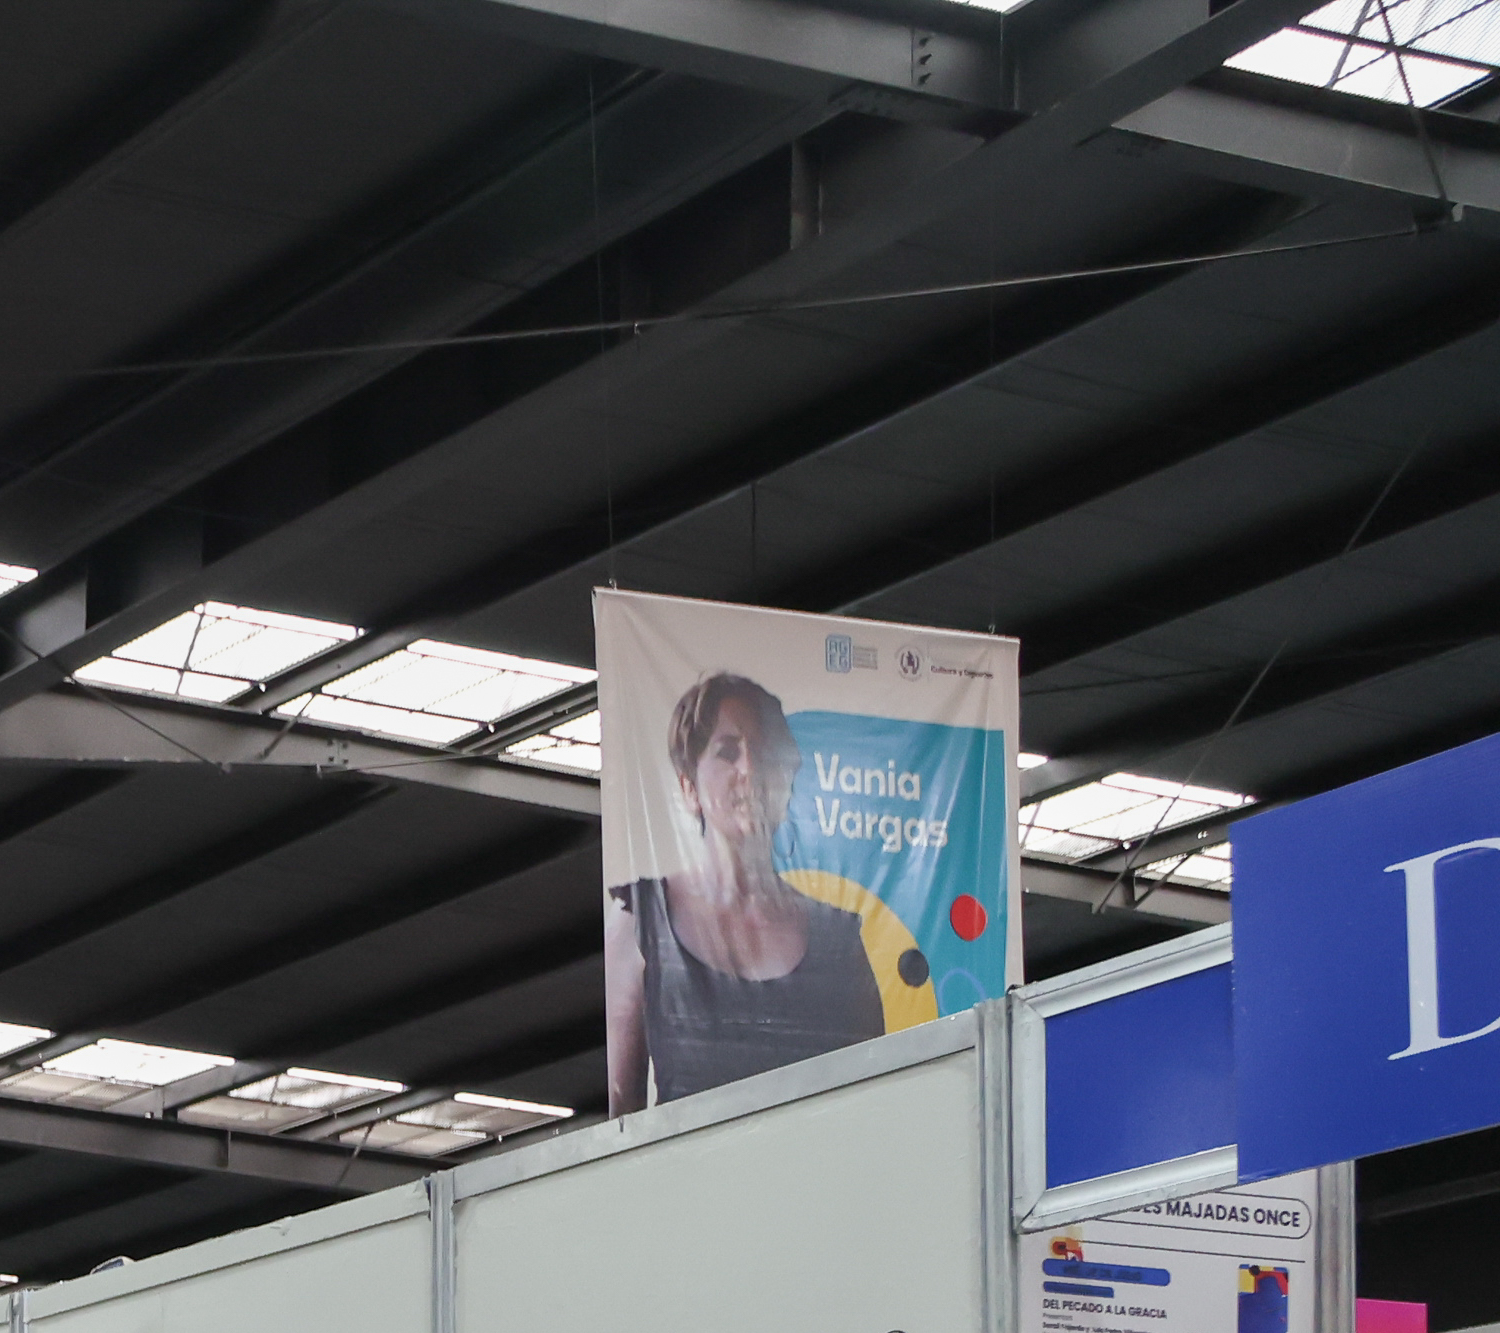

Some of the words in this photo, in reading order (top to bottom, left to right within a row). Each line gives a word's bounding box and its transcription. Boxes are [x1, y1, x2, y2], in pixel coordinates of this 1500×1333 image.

[814, 752, 921, 801] Vania
[815, 796, 948, 853] Vargas
[1166, 1201, 1250, 1223] MAJADAS
[1254, 1208, 1301, 1228] ONCE
[1043, 1298, 1061, 1310] DEL
[1062, 1301, 1104, 1314] PECADO
[1105, 1304, 1114, 1314] A
[1115, 1305, 1127, 1315] LA
[1128, 1306, 1168, 1319] GRACIA
